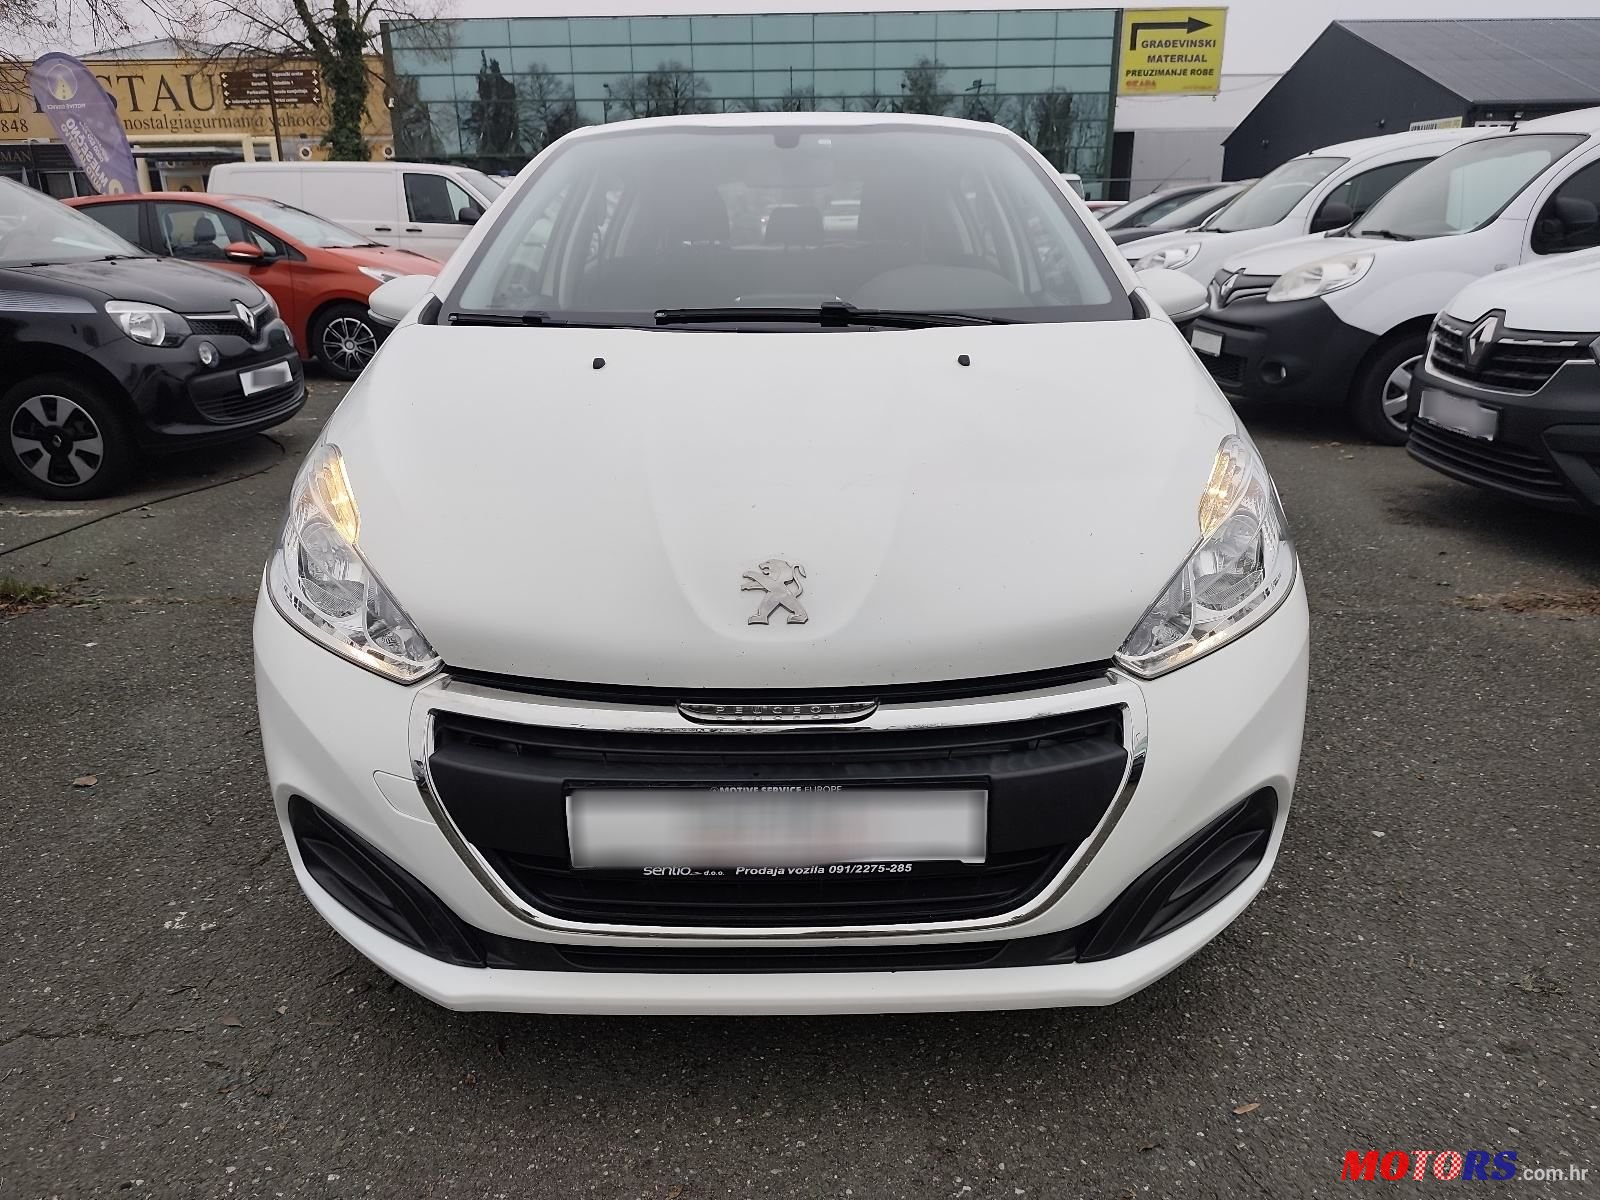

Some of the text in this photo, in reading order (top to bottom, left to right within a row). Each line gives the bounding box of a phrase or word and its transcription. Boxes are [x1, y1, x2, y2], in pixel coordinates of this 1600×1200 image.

[1141, 39, 1216, 48] GRAĐEVINSKI
[1147, 54, 1208, 63] MATERIJAL
[1125, 68, 1214, 77] PREUZIMANJE ROBE
[716, 705, 840, 714] PEUGEOT
[735, 866, 785, 877] Prodaja
[788, 865, 825, 874] vozila
[828, 863, 913, 874] 091/2275-285
